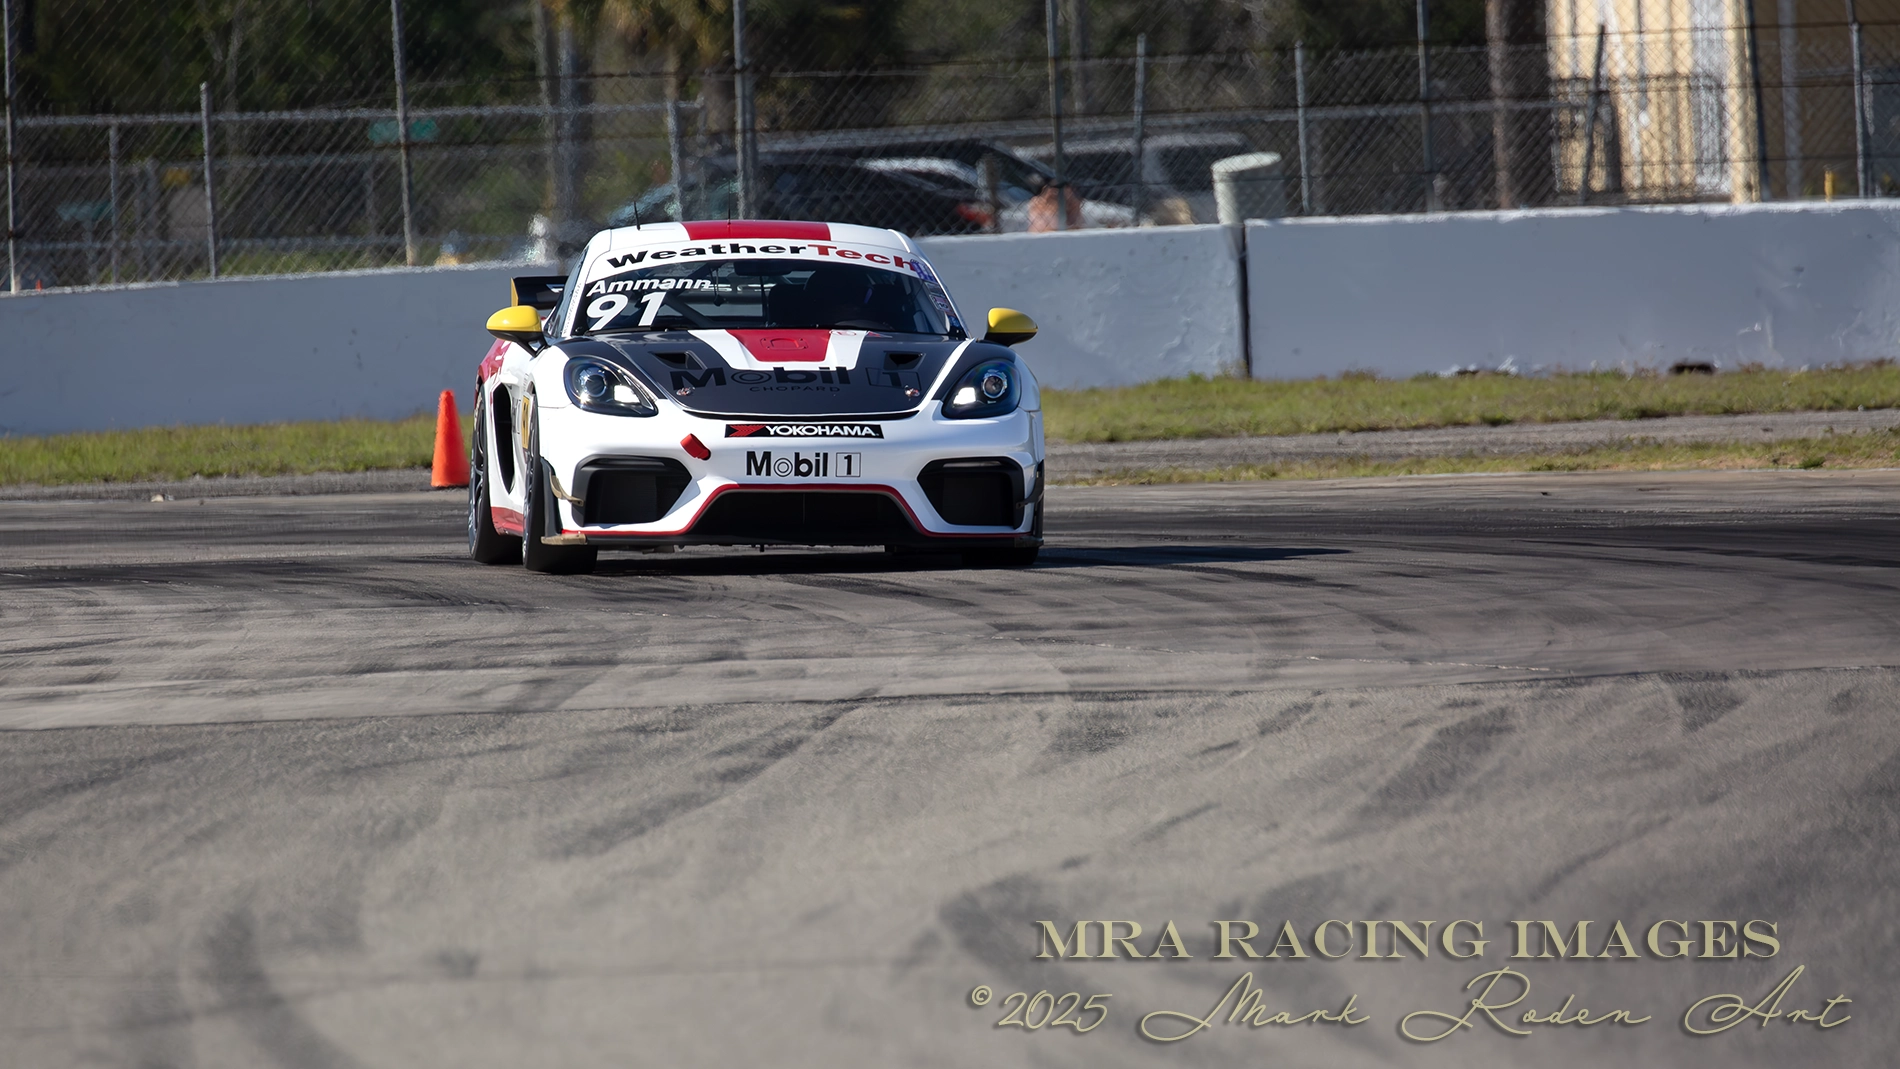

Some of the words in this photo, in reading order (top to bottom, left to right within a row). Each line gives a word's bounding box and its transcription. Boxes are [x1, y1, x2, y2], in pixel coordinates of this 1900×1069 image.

[607, 243, 916, 271] WeatherTech
[586, 278, 711, 297] Ammann
[586, 291, 667, 331] 91
[669, 366, 851, 390] Mobil
[765, 424, 877, 437] YOKOHAMA
[746, 451, 828, 477] Mobil
